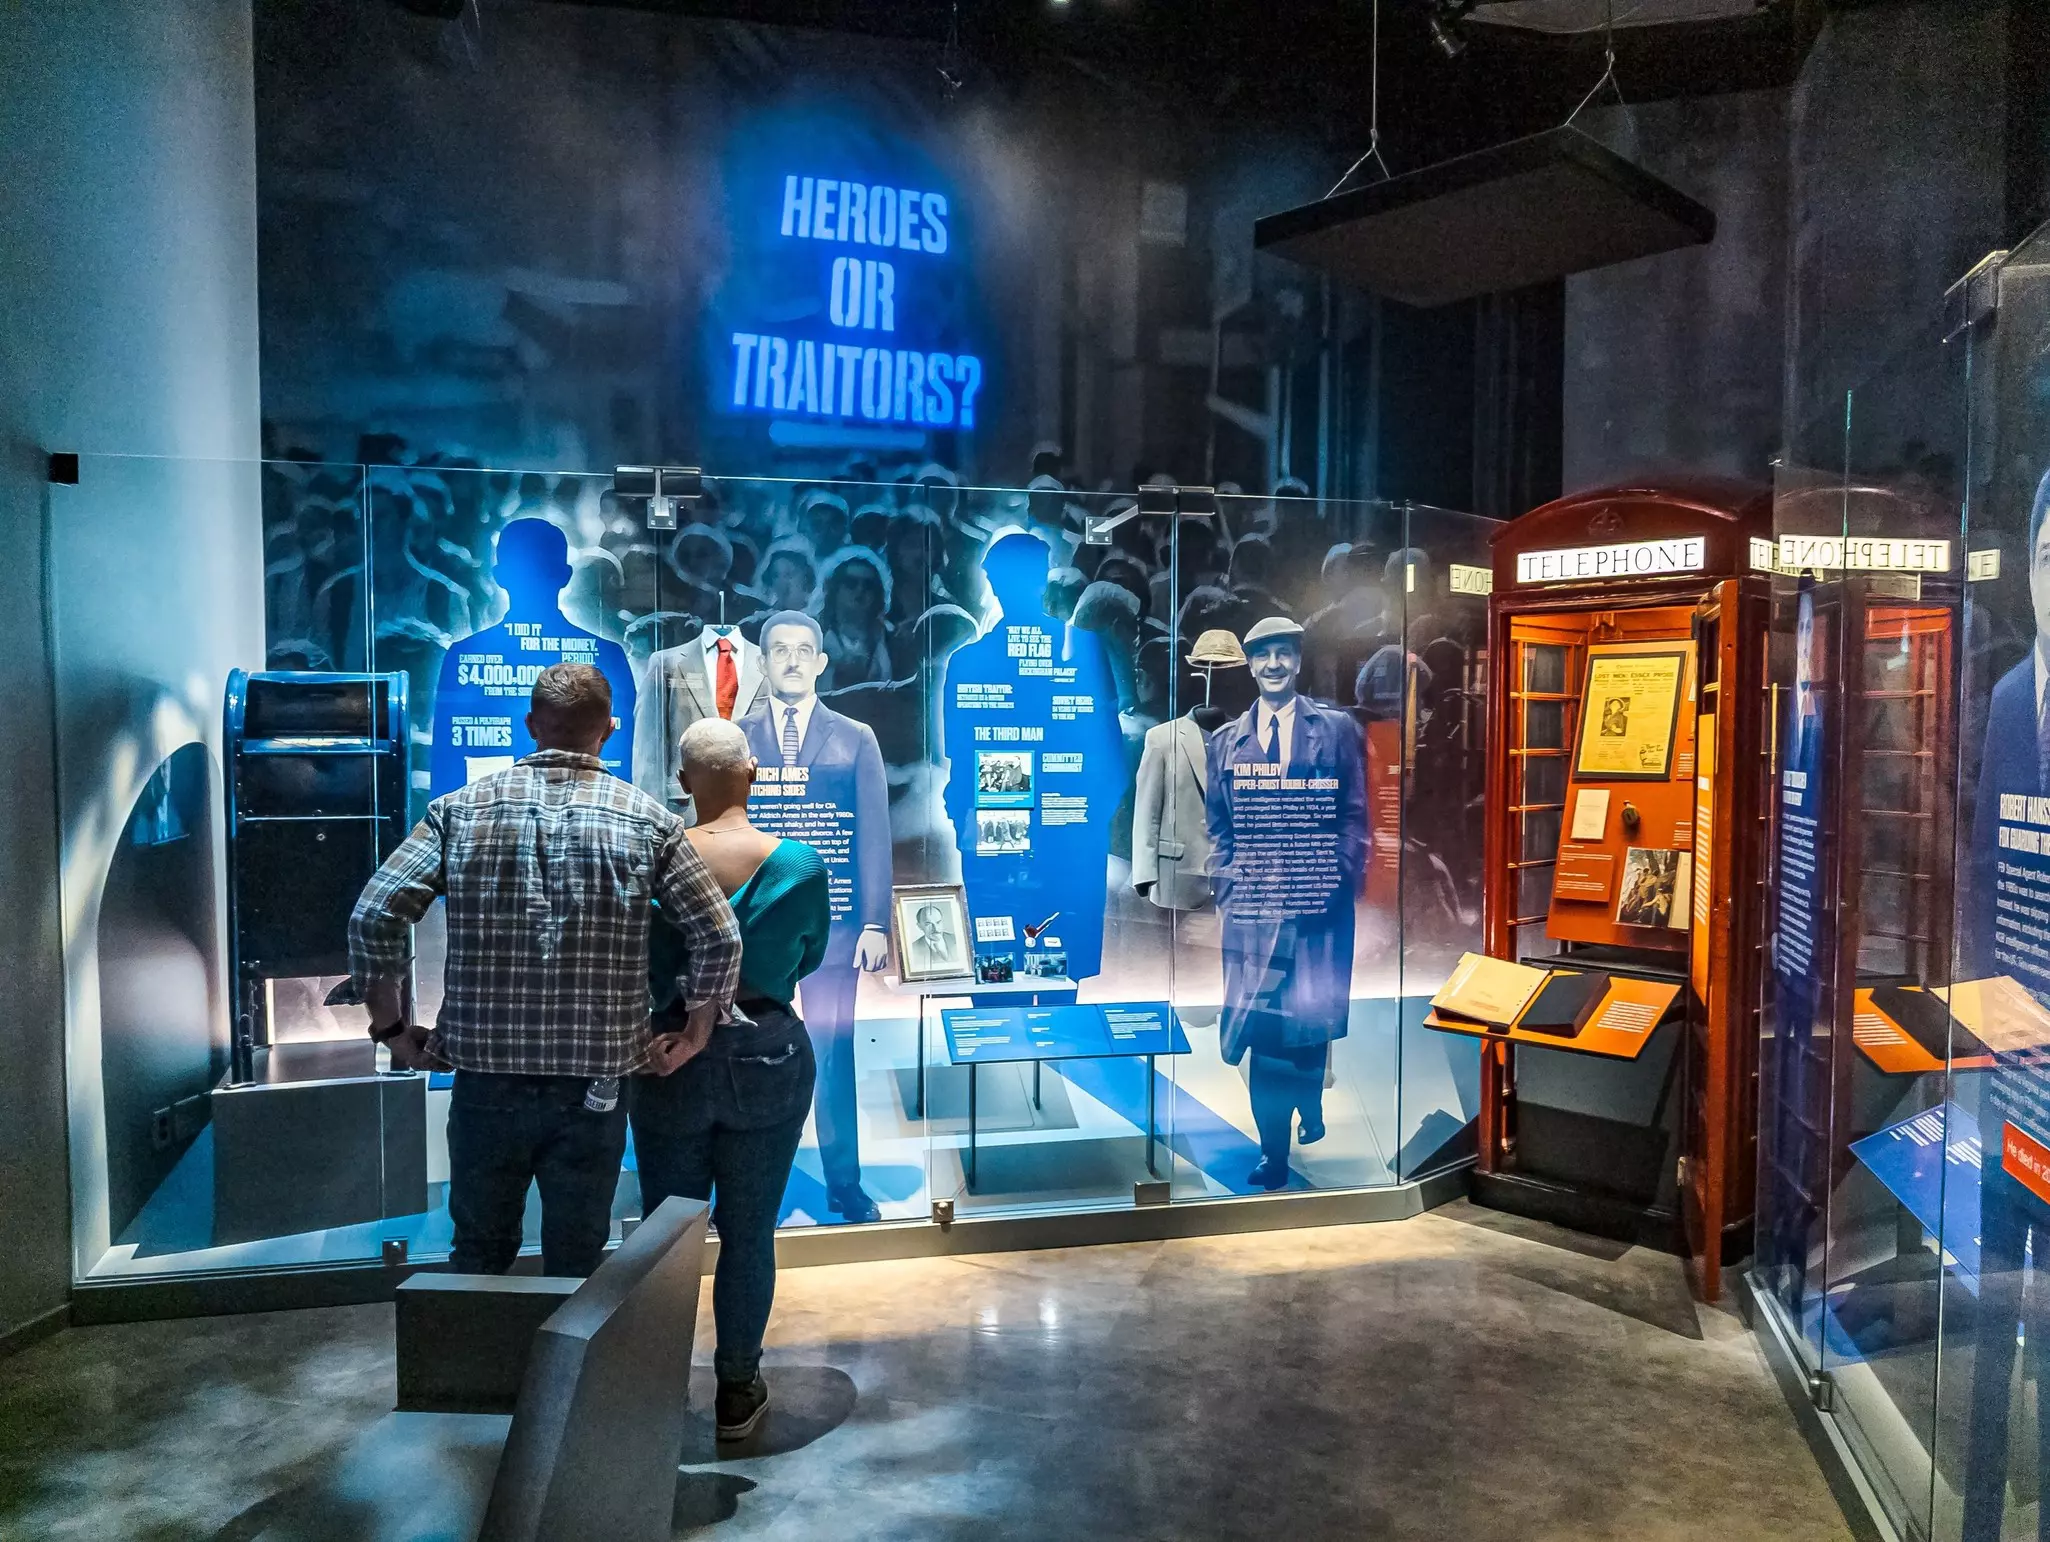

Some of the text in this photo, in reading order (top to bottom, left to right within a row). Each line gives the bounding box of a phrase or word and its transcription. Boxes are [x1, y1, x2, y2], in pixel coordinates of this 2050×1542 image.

[780, 175, 948, 254] HEROES
[830, 257, 895, 331] OR
[732, 332, 981, 427] TRAITORS?
[1523, 543, 1699, 580] TELEPHONE
[514, 623, 530, 636] DID
[532, 623, 542, 636] IT
[520, 637, 598, 652] FOR THE MONEY.
[1008, 643, 1052, 657] RED FLAG
[452, 726, 512, 747] 3 TIMES
[974, 727, 1044, 741] THE THIRD MAN
[756, 767, 809, 782] RICH AMES
[1233, 763, 1281, 776] KIM PHILBY
[750, 784, 806, 796] ITCHING SIDES
[819, 812, 834, 820] early
